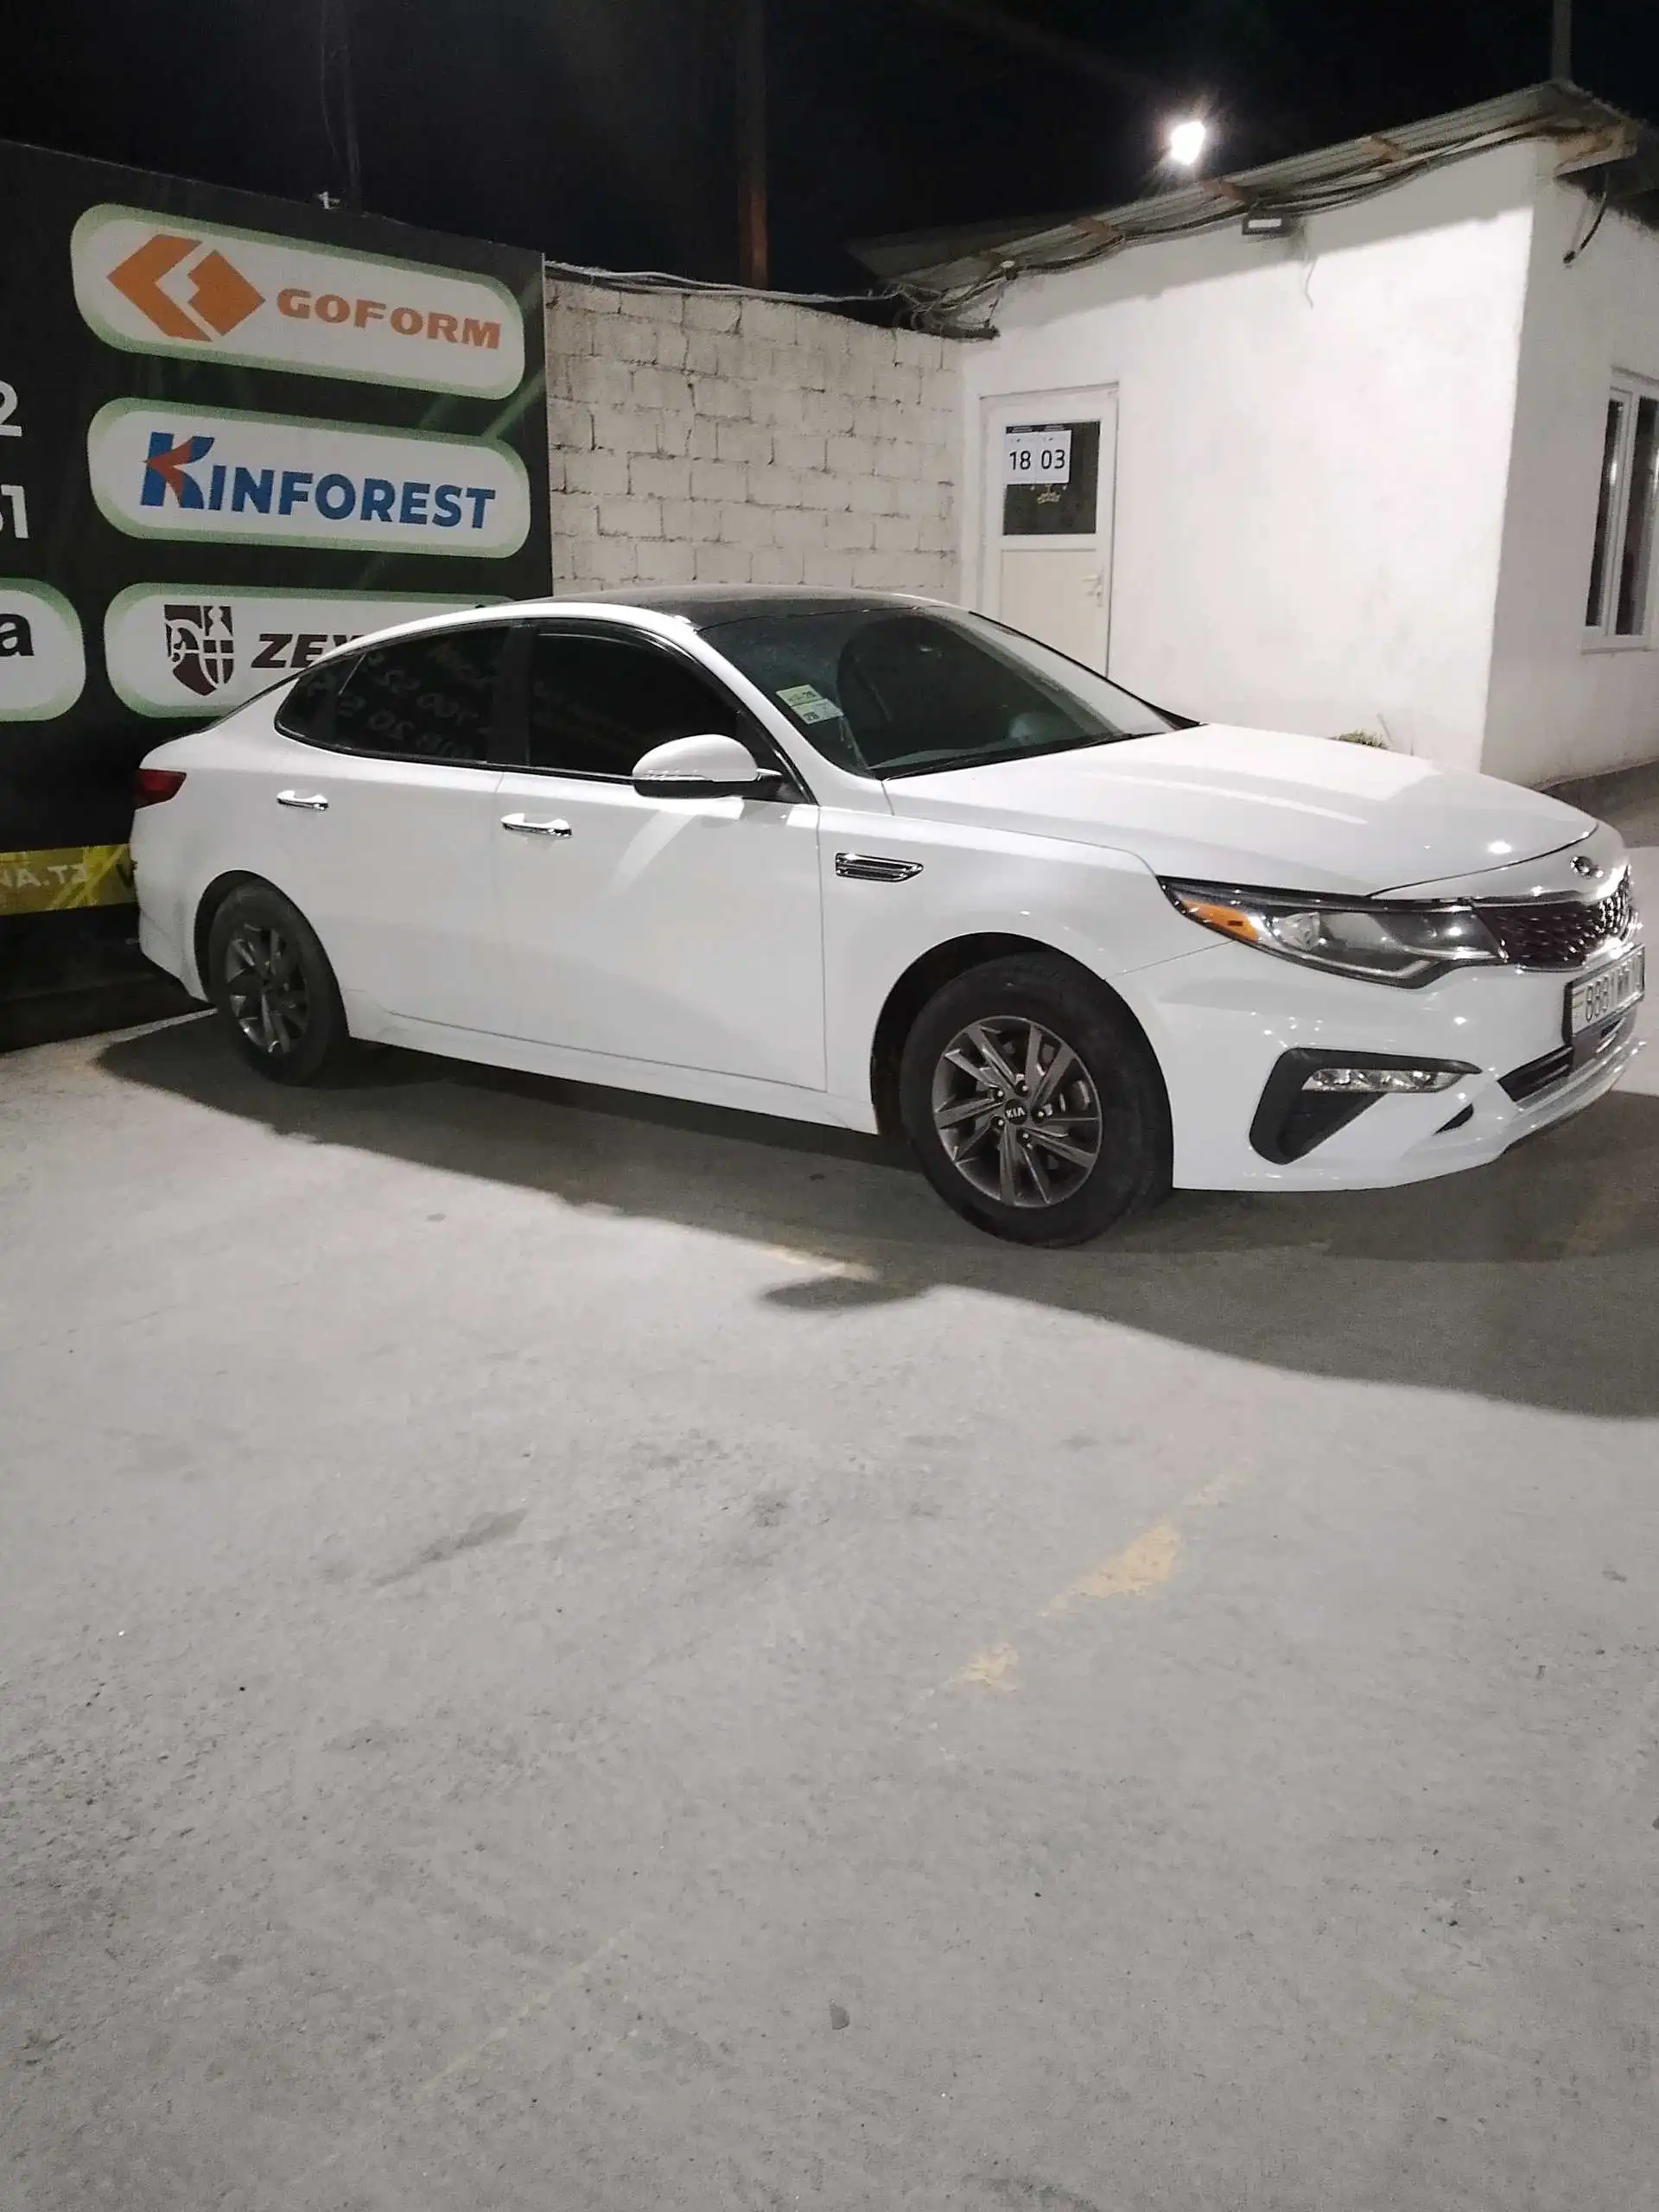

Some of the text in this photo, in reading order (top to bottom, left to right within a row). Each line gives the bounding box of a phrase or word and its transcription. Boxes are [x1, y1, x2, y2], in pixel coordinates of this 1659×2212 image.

[276, 288, 501, 349] GOFORM
[141, 431, 496, 529] KINFOREST
[1009, 449, 1065, 470] 18 03
[1006, 1107, 1026, 1118] KIA
